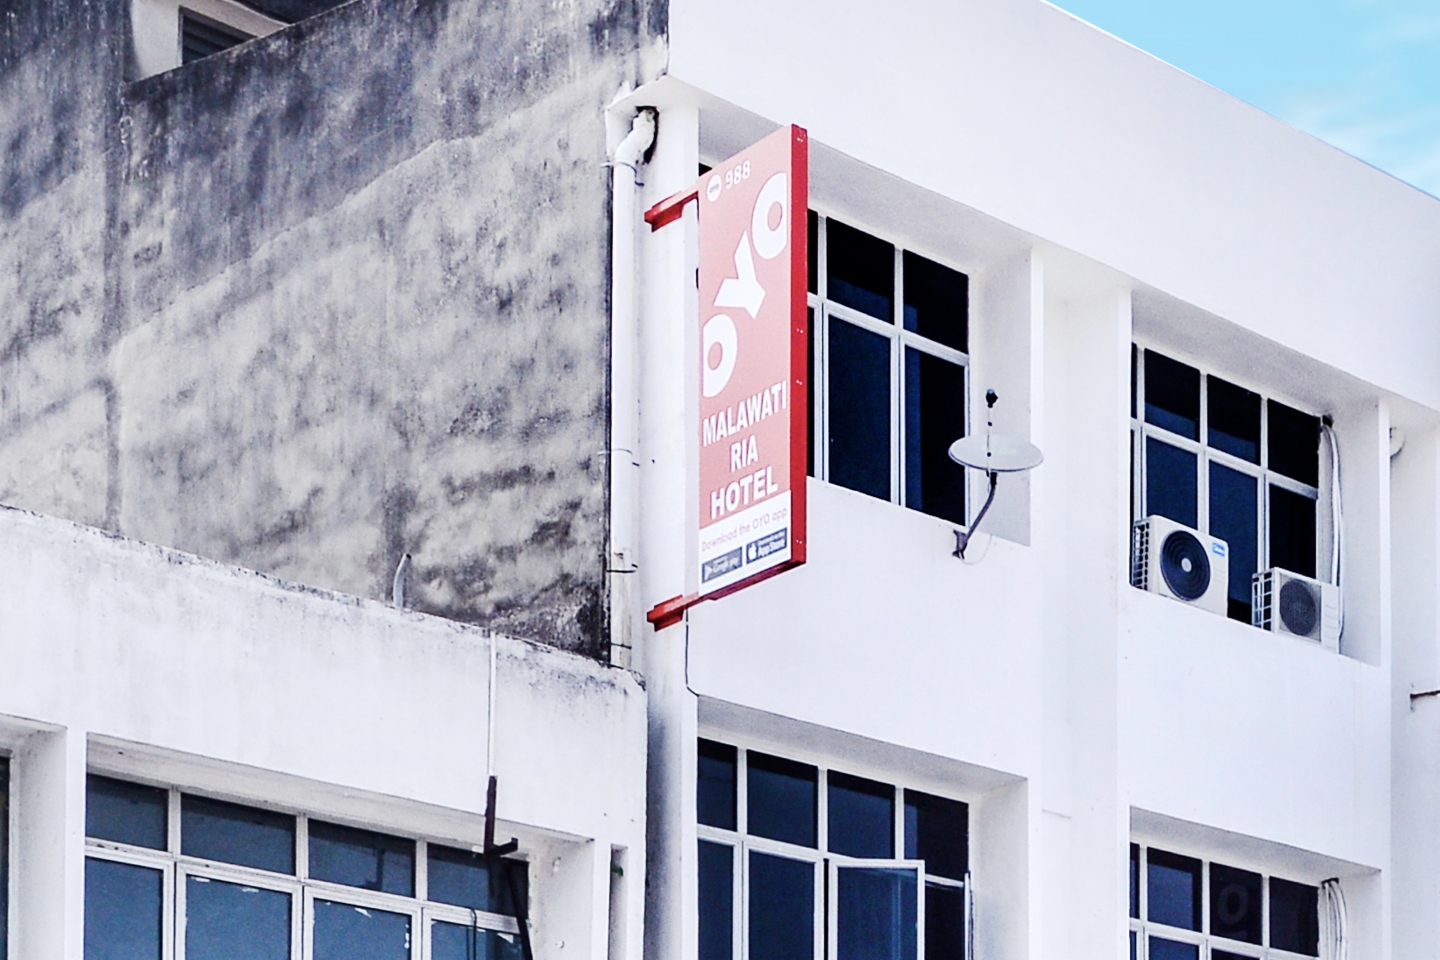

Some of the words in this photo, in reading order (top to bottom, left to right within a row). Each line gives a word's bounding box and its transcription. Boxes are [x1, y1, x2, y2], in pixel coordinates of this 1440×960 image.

[725, 160, 750, 189] 988
[703, 172, 787, 398] OYO
[703, 380, 787, 447] MALAWATI
[730, 434, 759, 474] RIA
[711, 465, 778, 519] HOTEL
[752, 513, 770, 529] OYO
[772, 508, 787, 522] app
